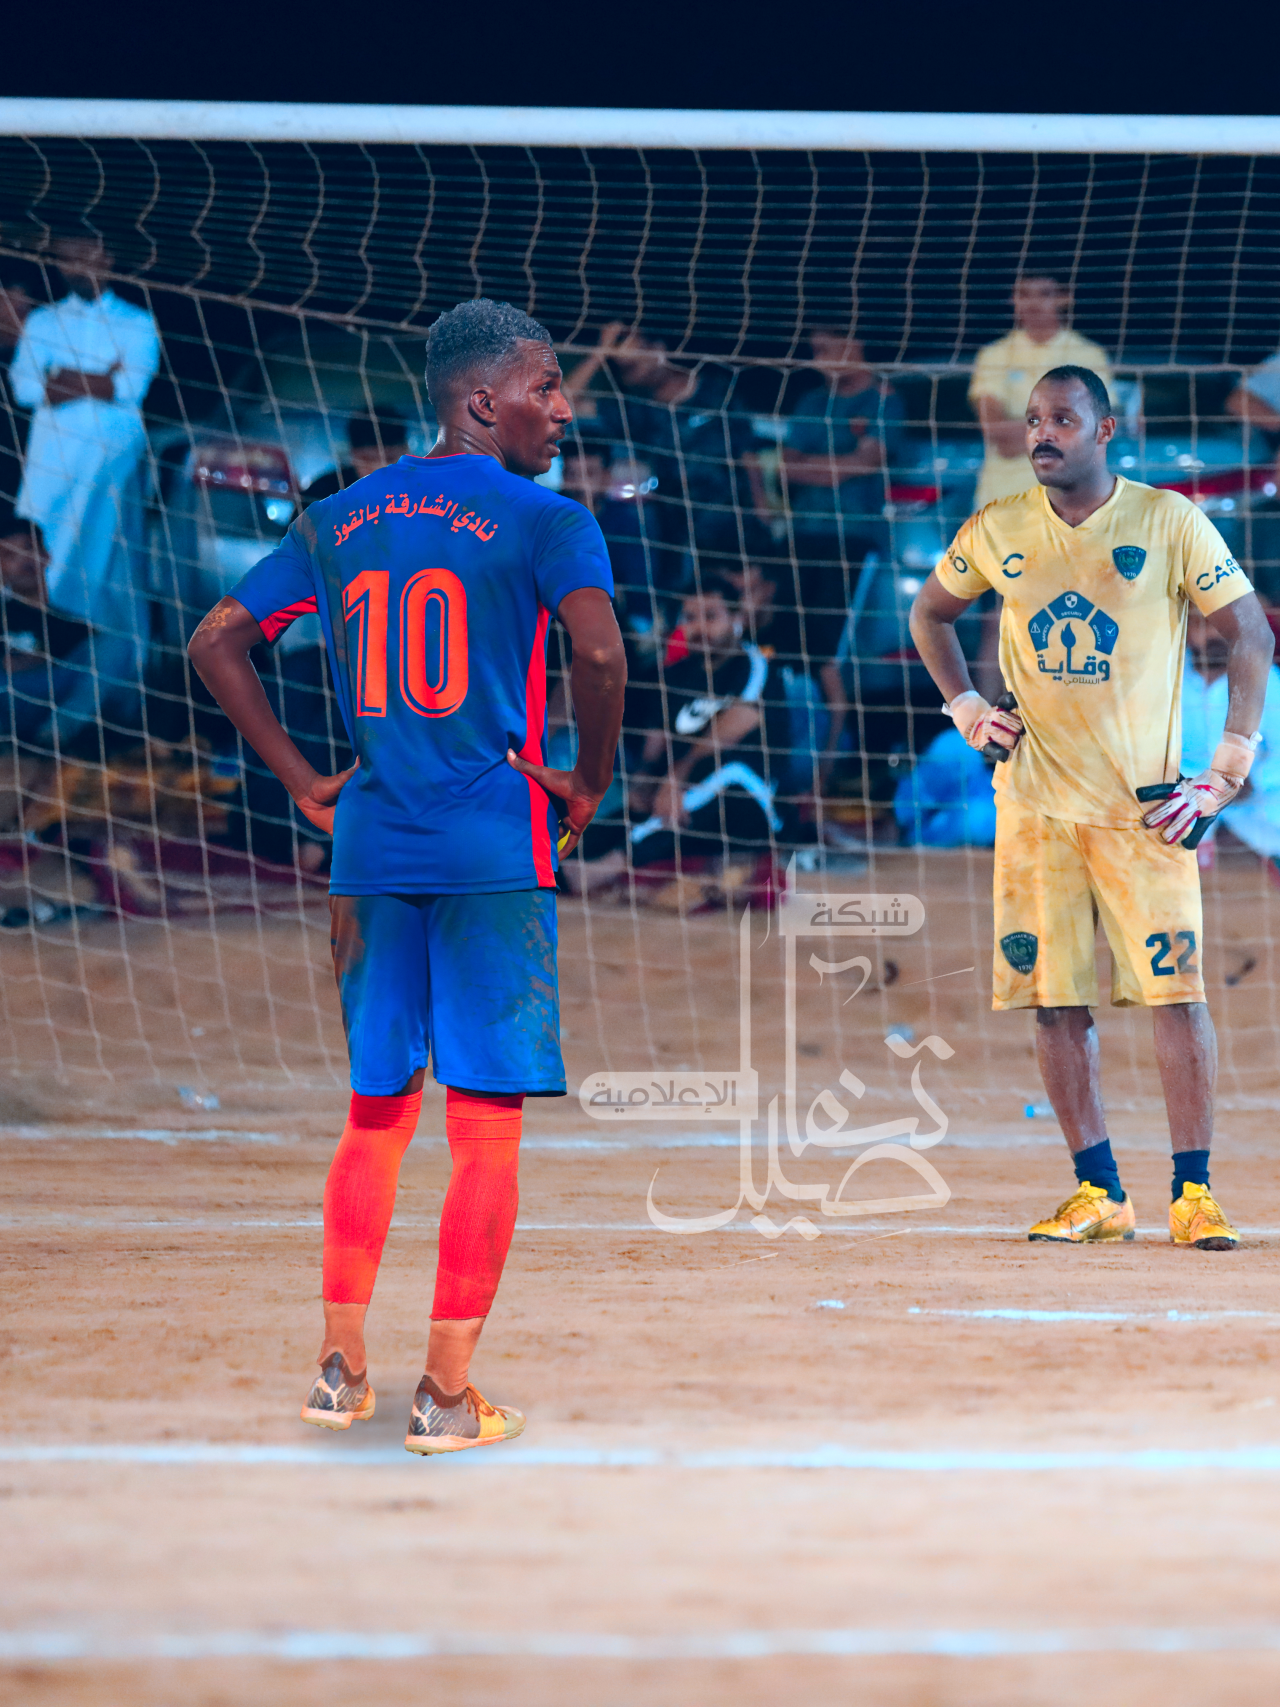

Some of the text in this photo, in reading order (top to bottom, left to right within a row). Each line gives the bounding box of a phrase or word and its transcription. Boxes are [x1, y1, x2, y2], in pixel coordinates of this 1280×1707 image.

[333, 493, 498, 546] نادي الشارقة بالقوز
[342, 568, 469, 719] 10
[1042, 623, 1050, 643] SAFETY
[1092, 624, 1102, 646] QUALITY
[1037, 653, 1111, 682] وقاية
[1145, 930, 1199, 977] 22
